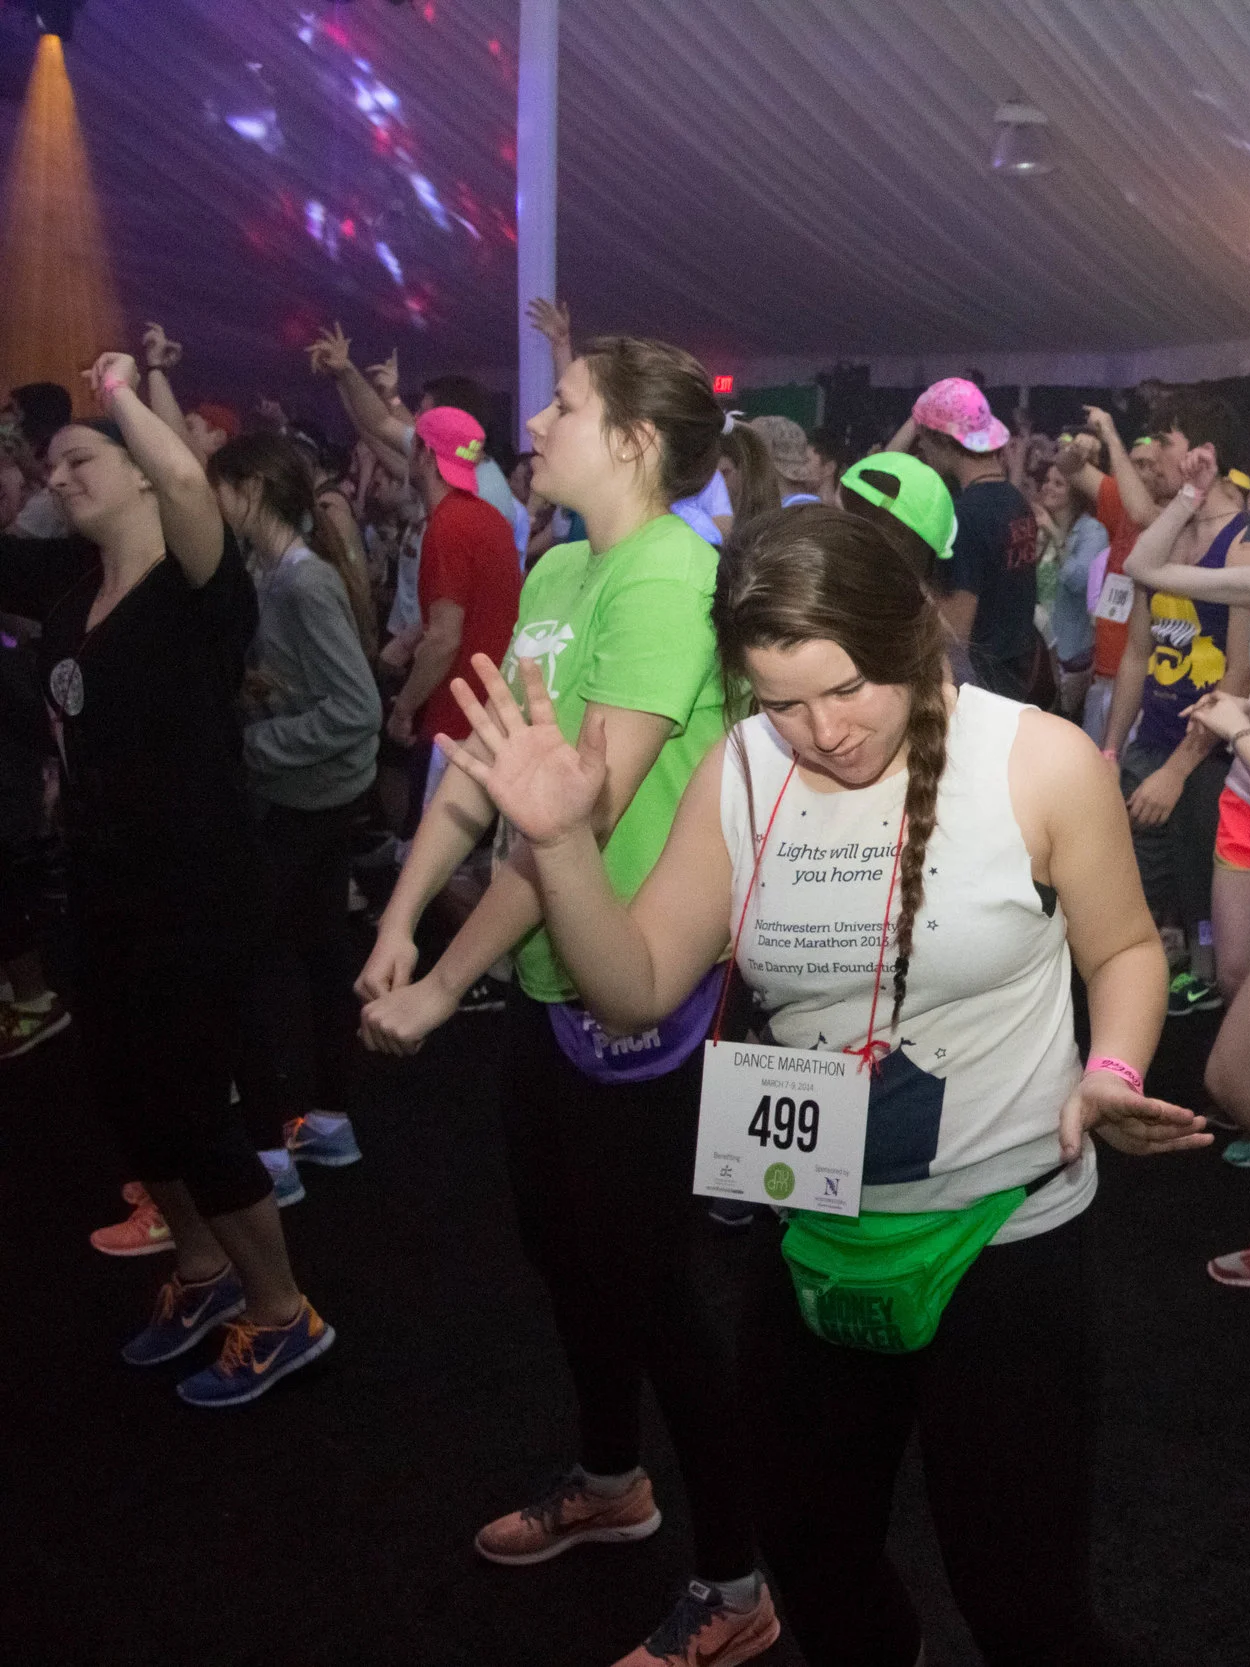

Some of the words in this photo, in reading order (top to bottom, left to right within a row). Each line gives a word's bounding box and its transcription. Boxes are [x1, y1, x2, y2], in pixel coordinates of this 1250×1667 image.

[714, 377, 733, 391] EXIT
[777, 842, 826, 862] Lights
[829, 844, 859, 859] will
[861, 842, 903, 862] guid
[792, 868, 826, 885] you
[830, 867, 883, 882] home
[754, 919, 831, 933] Northwestern
[758, 935, 791, 948] Dance
[794, 937, 857, 948] Marathon
[748, 958, 764, 971] The
[765, 961, 804, 976] Danny
[807, 962, 829, 973] Did
[833, 961, 897, 974] Foundatio
[734, 1052, 775, 1070] DANCE
[778, 1057, 845, 1077] MARATHON
[761, 1078, 784, 1088] MARCH
[798, 1082, 814, 1092] 2014
[748, 1095, 820, 1153] 499
[824, 1176, 840, 1196] N
